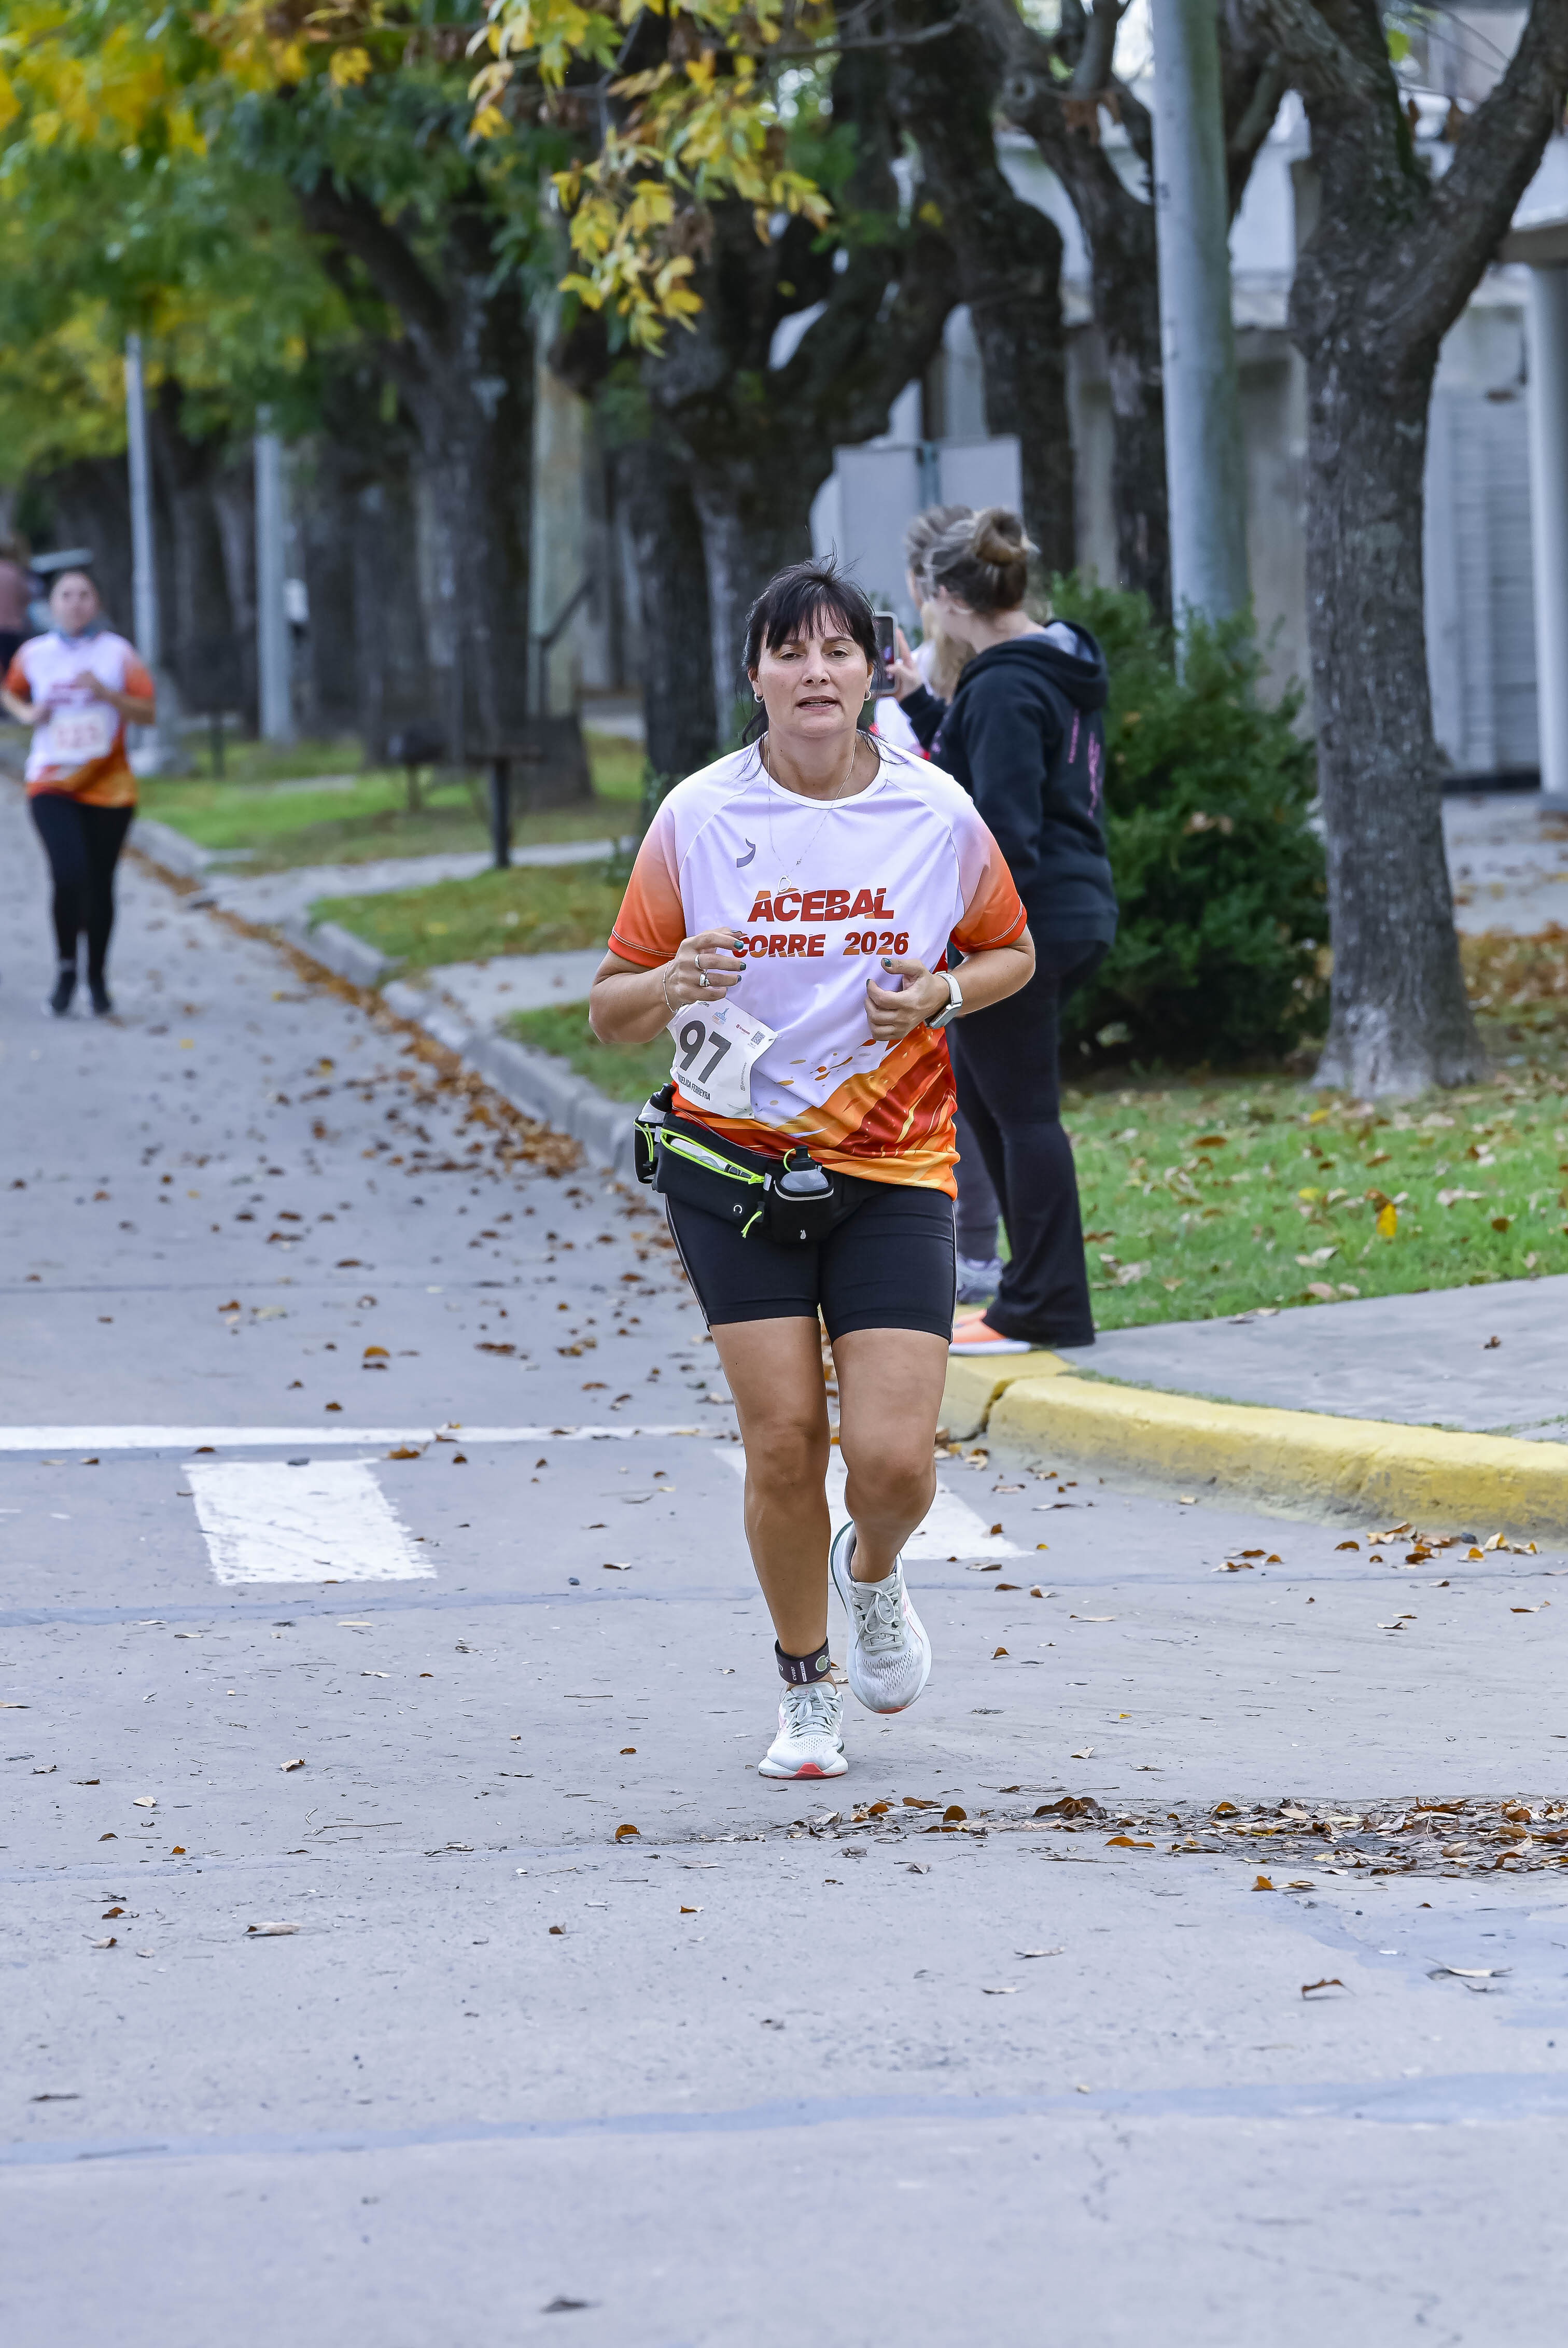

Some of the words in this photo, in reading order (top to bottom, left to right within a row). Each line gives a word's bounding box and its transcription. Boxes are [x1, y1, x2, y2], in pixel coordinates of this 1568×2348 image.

[747, 888, 894, 922] ACEBAL
[732, 933, 825, 958] CORRE
[843, 931, 909, 956] 2026
[679, 1020, 732, 1084] 97
[676, 1071, 691, 1089] GELICA
[691, 1083, 710, 1101] FERREYRA
